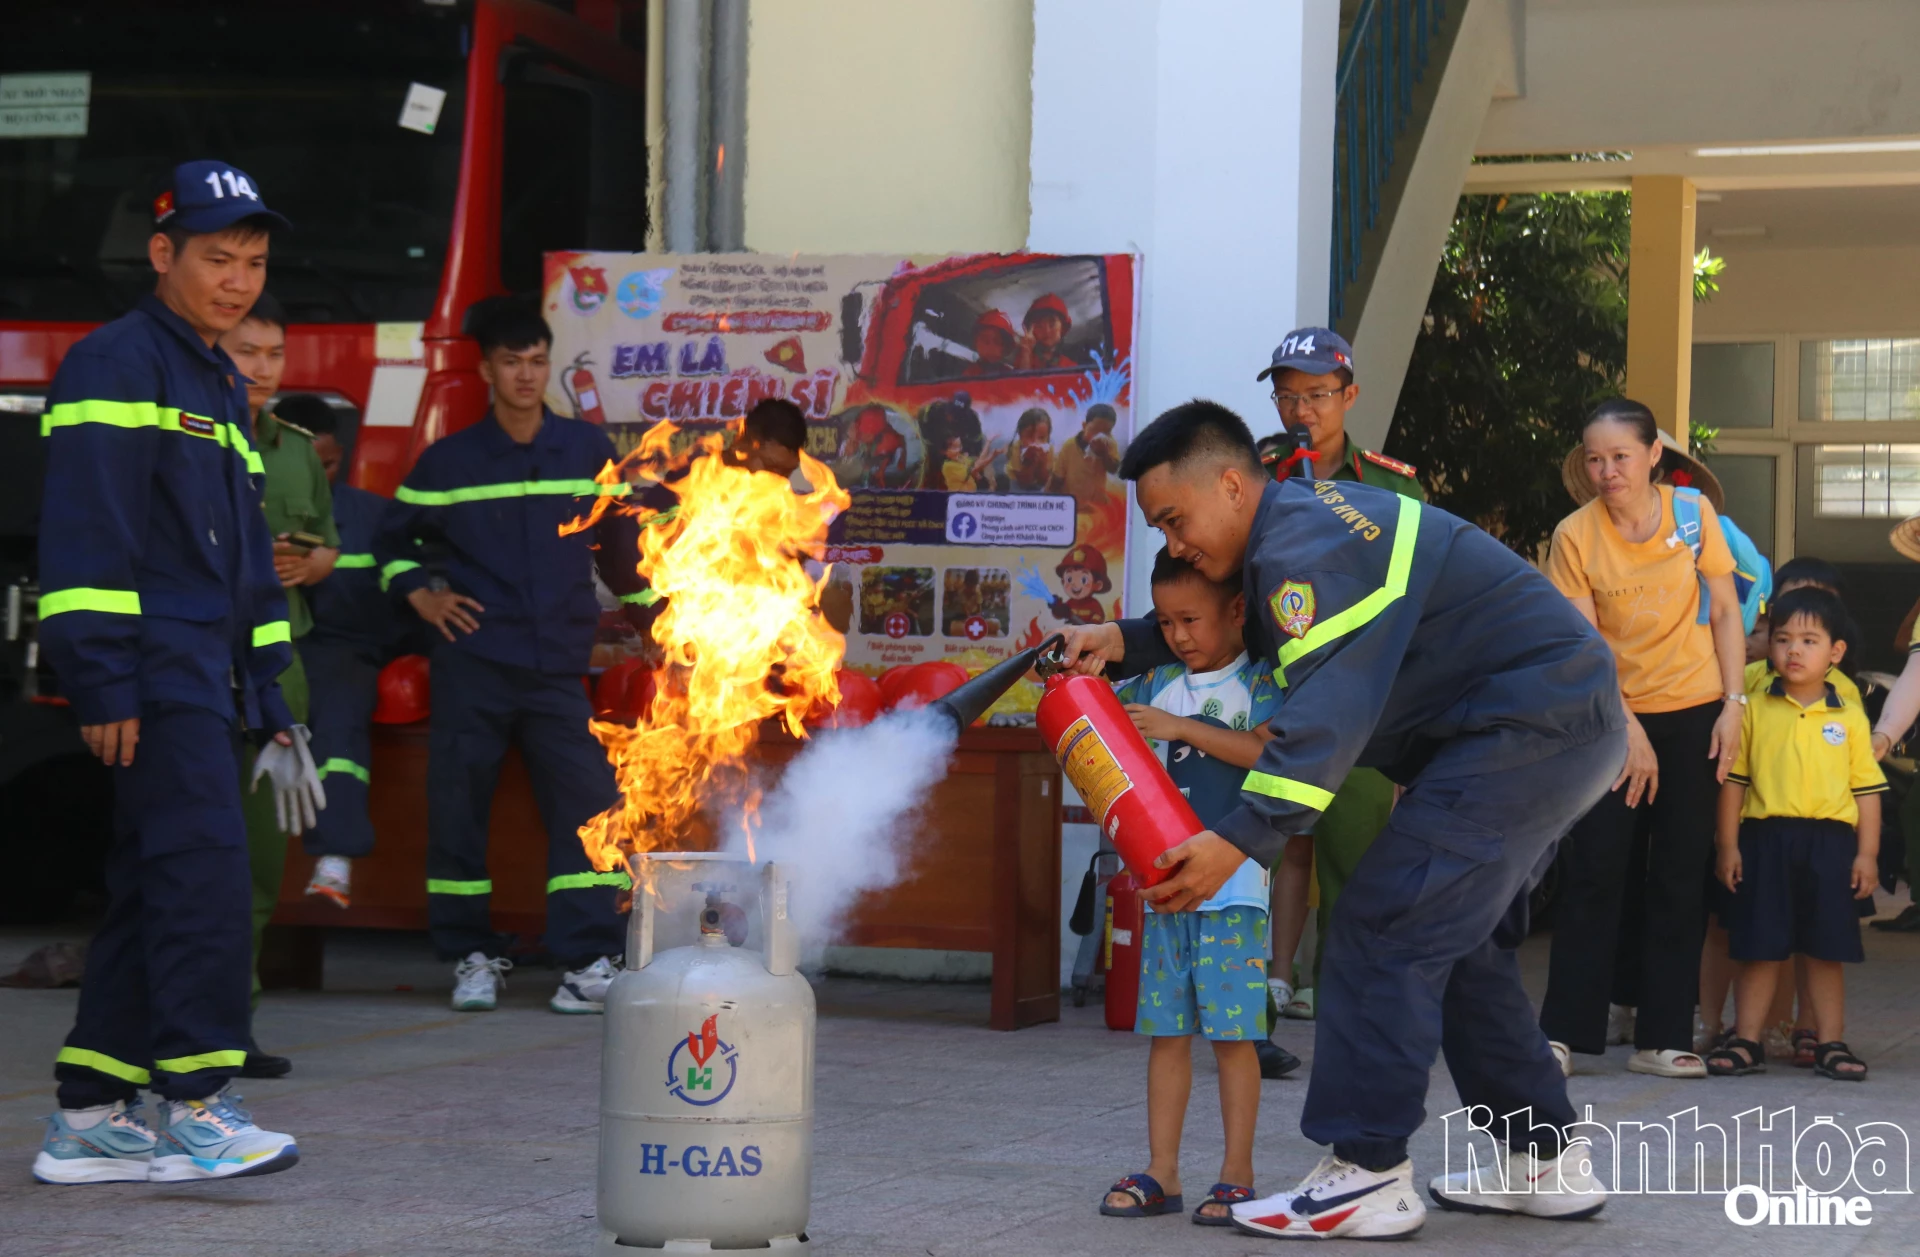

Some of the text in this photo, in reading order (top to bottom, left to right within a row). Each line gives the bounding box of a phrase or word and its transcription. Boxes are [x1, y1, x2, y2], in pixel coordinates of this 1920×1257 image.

[205, 170, 259, 201] 114
[611, 341, 670, 378] EM
[1281, 335, 1316, 357] 114
[1331, 504, 1381, 541] CẢNH
[1607, 585, 1644, 598] GET IT
[639, 1143, 763, 1177] H-GAS
